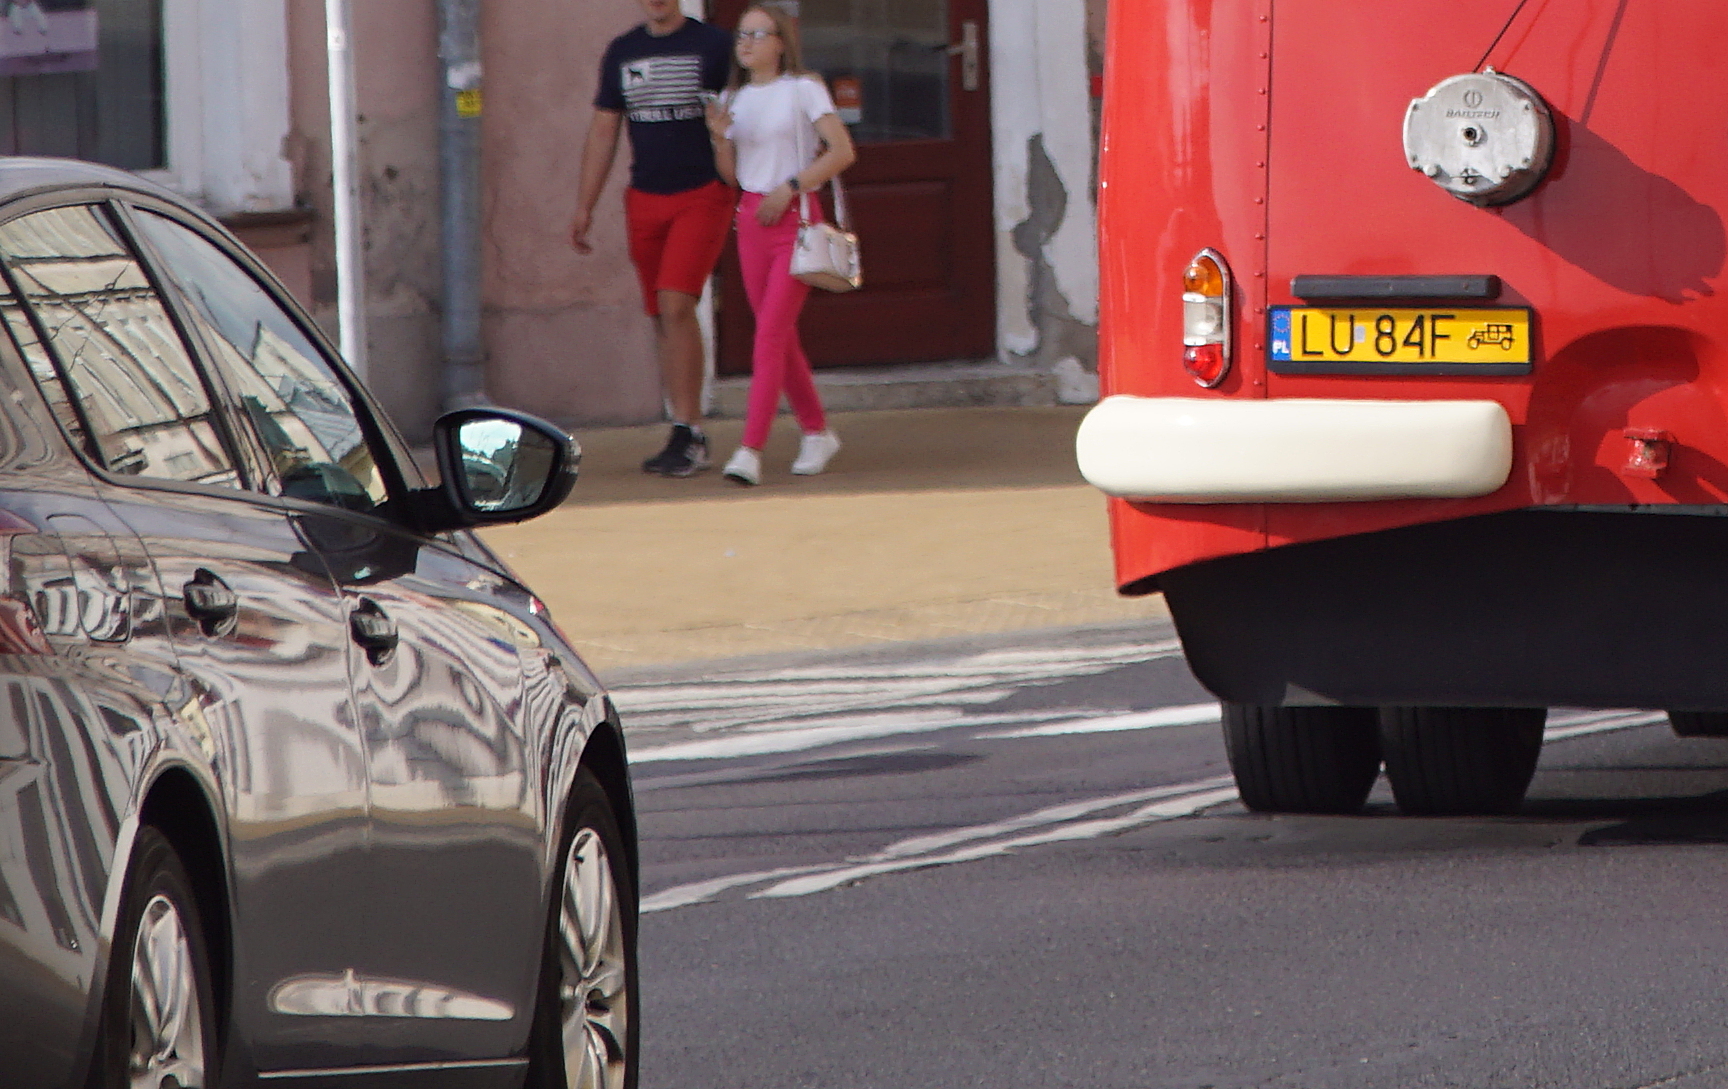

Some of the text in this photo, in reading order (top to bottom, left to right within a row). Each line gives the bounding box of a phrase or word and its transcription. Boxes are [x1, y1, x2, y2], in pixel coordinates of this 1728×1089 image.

[1272, 340, 1290, 354] PL
[1302, 314, 1456, 358] LU 84F
